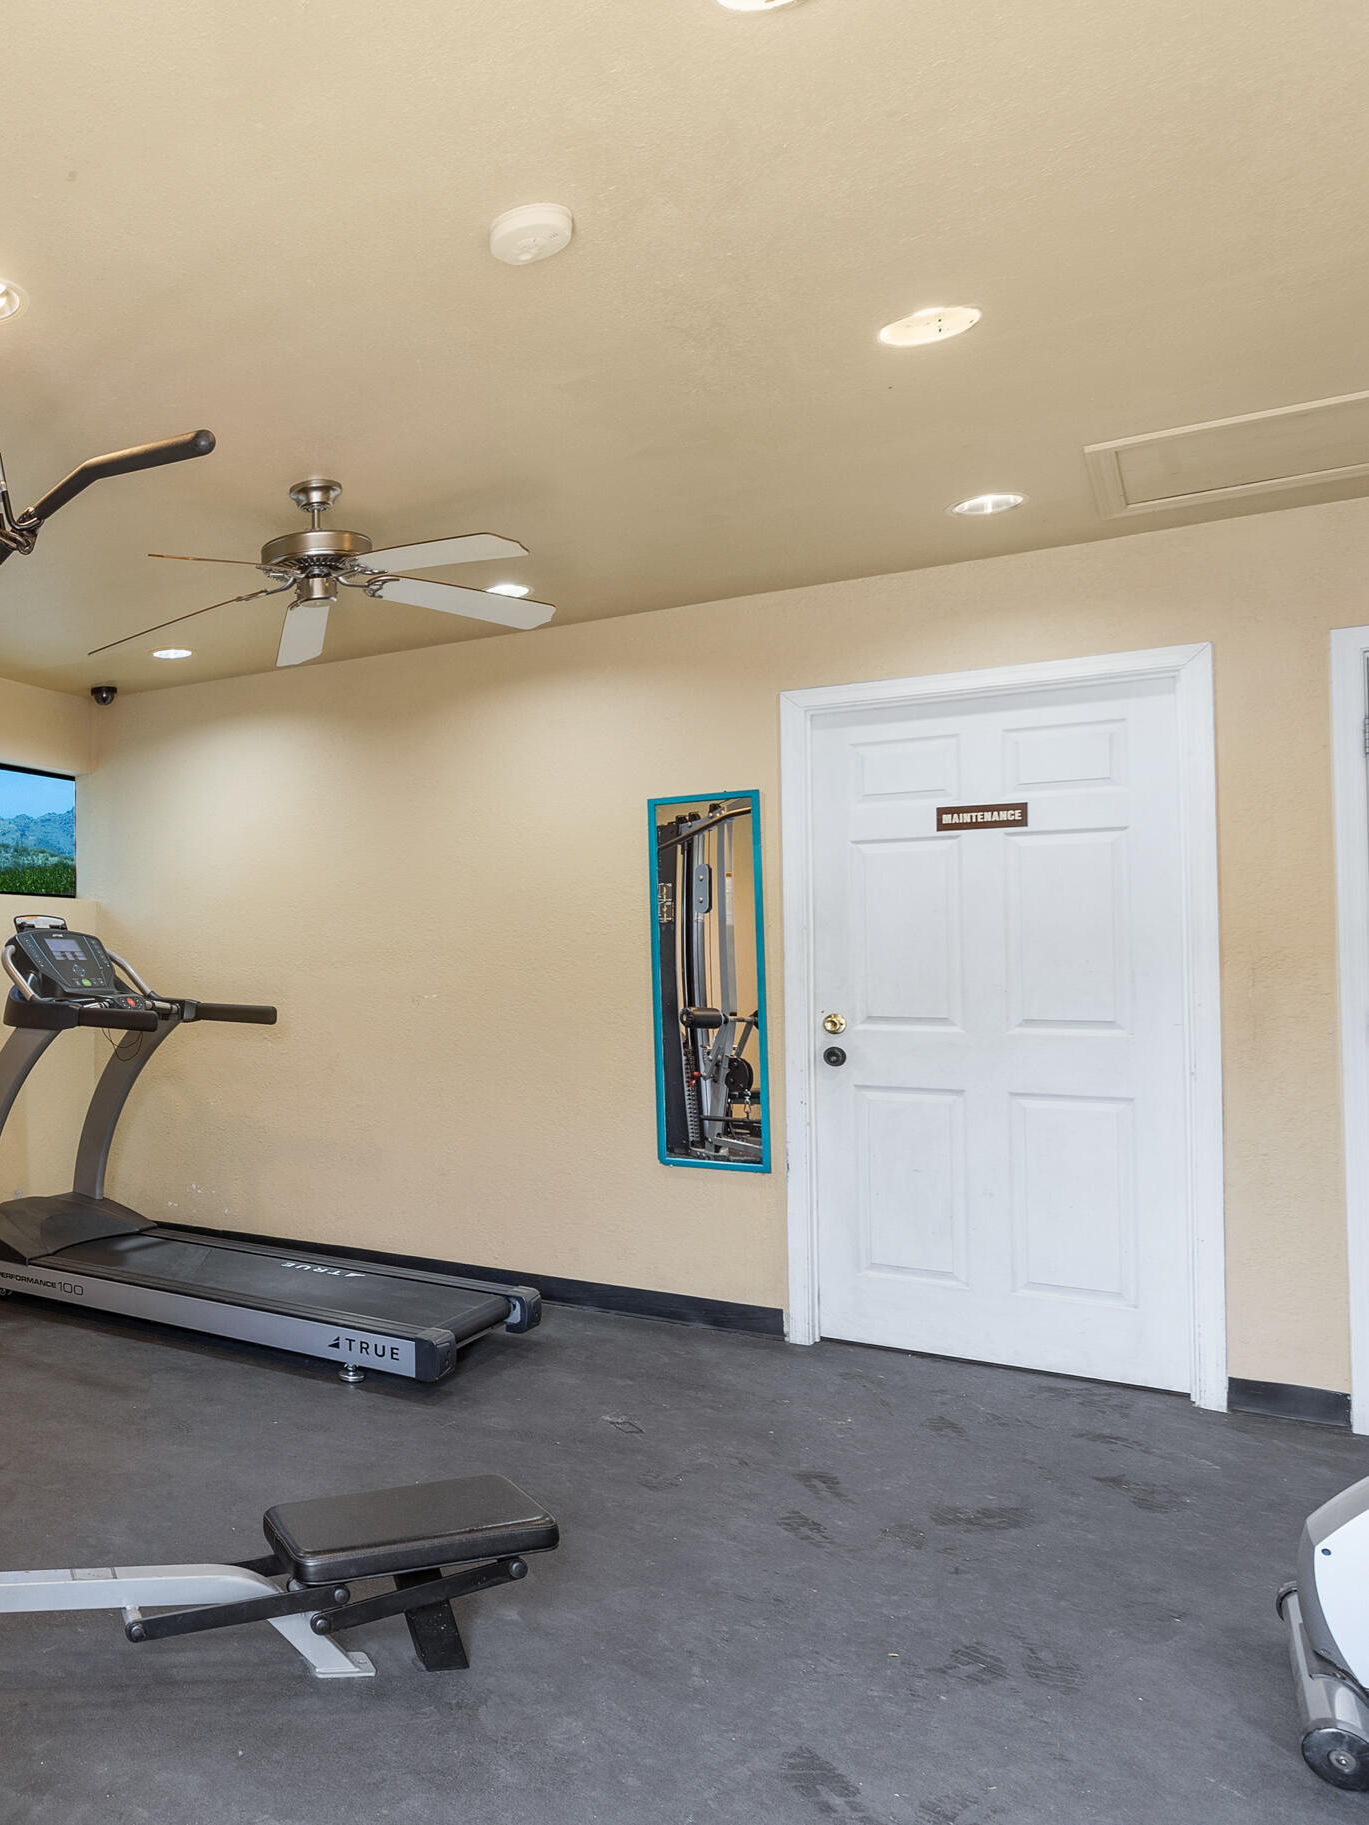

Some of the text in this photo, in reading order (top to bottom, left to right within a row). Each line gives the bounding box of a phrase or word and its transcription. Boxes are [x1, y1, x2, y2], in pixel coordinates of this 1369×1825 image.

[941, 809, 1023, 825] MAINTENANCE
[281, 1262, 341, 1276] TRUE
[57, 1281, 84, 1296] 100
[344, 1337, 400, 1361] TRUE
